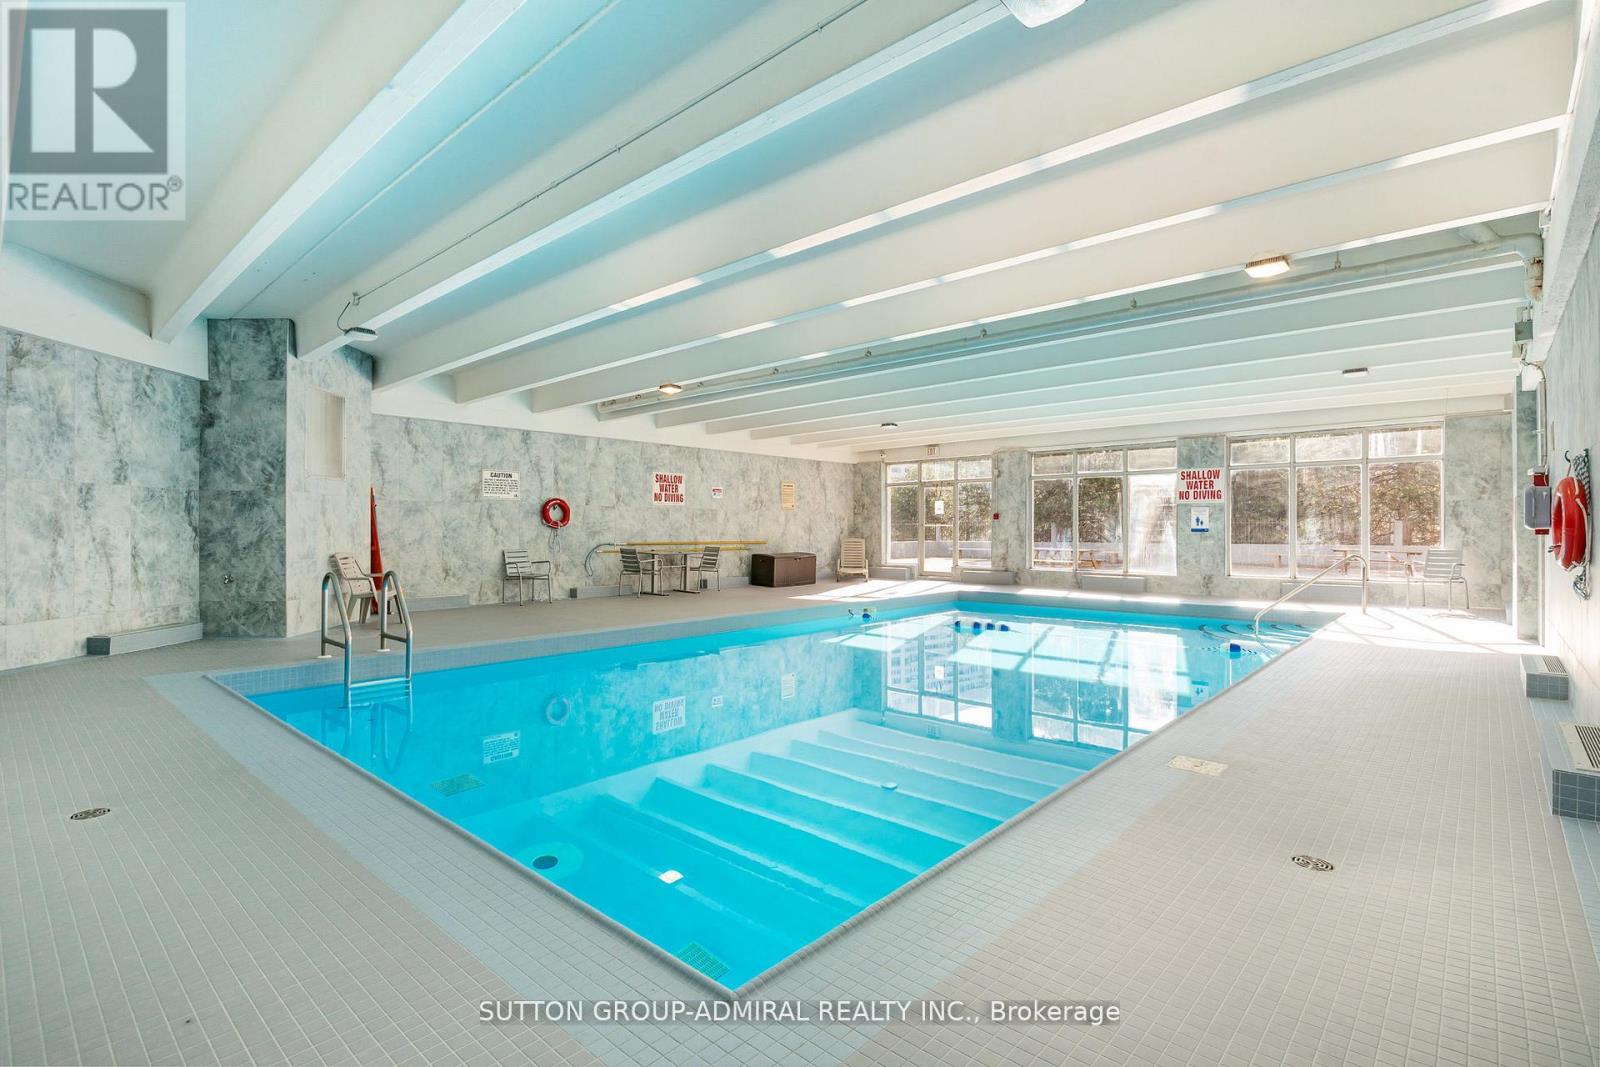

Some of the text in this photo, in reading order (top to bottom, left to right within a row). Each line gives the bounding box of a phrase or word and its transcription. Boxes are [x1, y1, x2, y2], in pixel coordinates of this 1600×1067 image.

[655, 473, 683, 484] SHALLOW
[1180, 469, 1221, 480] SHALLOW
[659, 484, 678, 493] WATER
[1186, 480, 1214, 490] WATER
[654, 492, 684, 503] NO DIVING
[1178, 489, 1222, 500] NO DIVING
